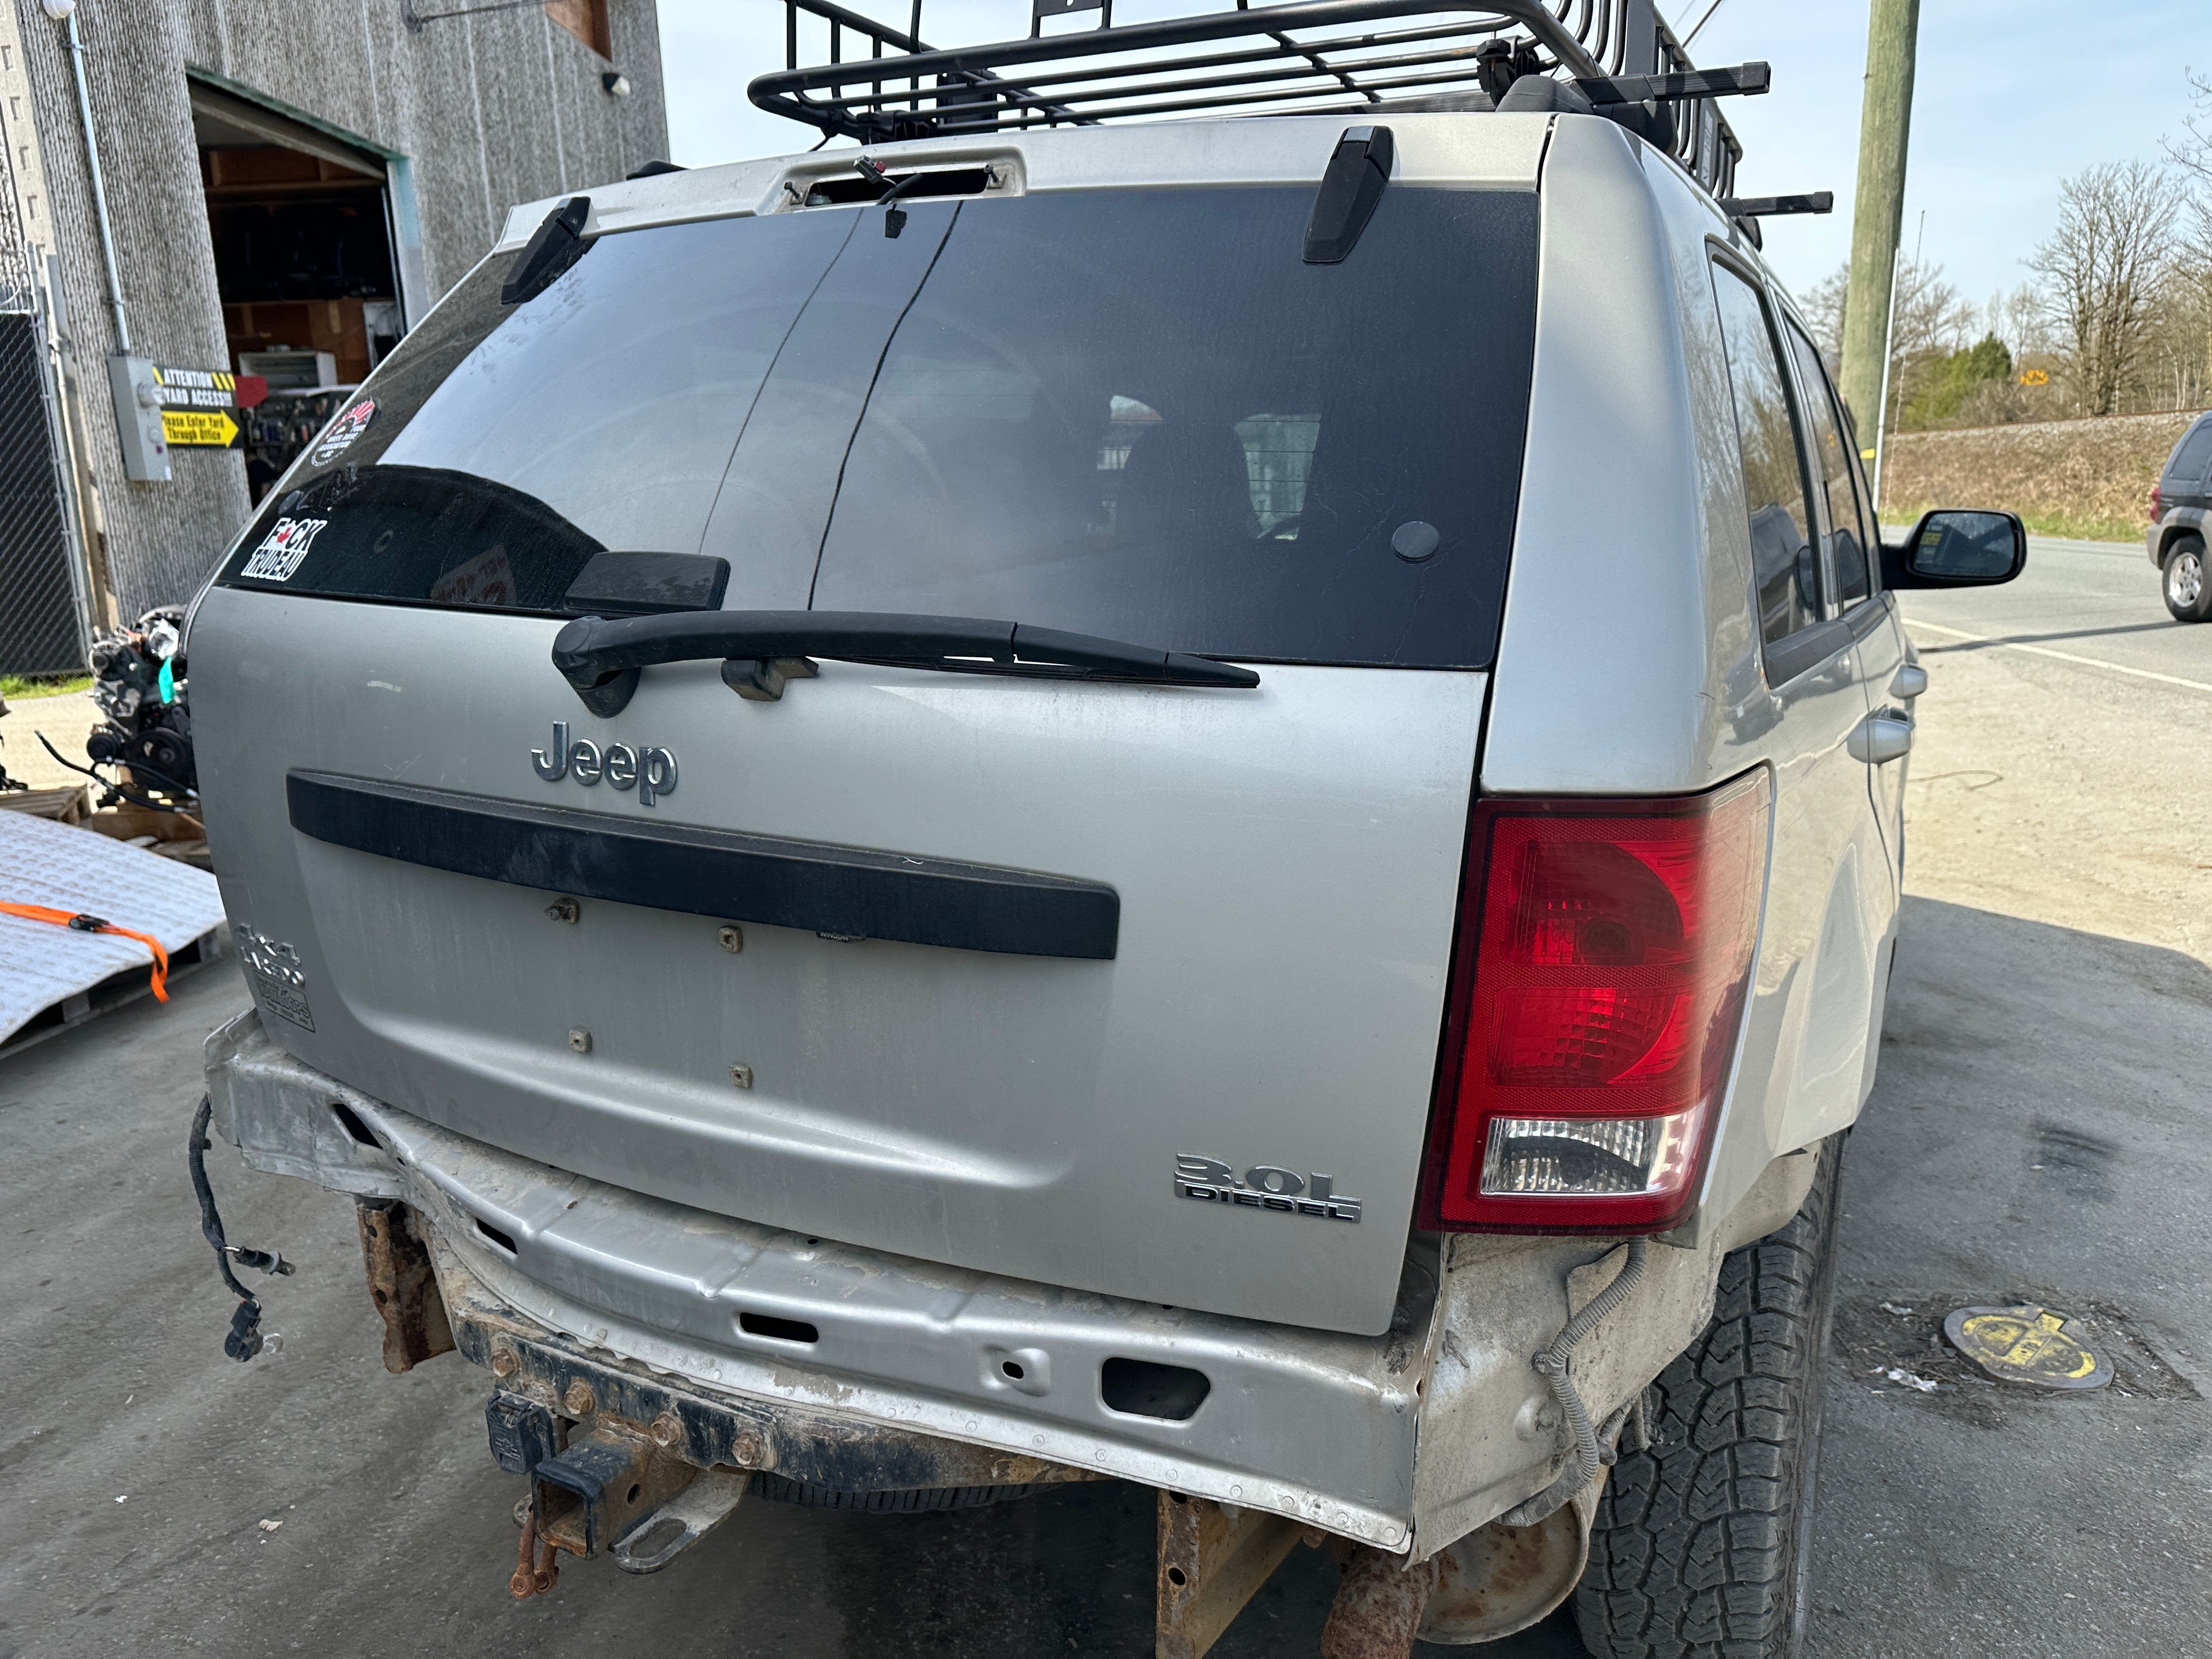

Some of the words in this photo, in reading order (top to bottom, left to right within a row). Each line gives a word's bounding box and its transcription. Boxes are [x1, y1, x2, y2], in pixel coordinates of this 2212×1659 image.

[164, 368, 213, 388] ATTENTION
[164, 387, 189, 404] YARD
[186, 415, 206, 428] Enter
[208, 415, 224, 429] Yard
[168, 427, 197, 443] Through
[199, 428, 221, 441] Office
[262, 518, 326, 551] FCK
[243, 548, 306, 579] TRUDEAU
[531, 721, 677, 806] Jeep
[820, 931, 849, 941] WINDOW
[1175, 1153, 1362, 1205] 3.0L
[1184, 1182, 1357, 1222] DIESEL
